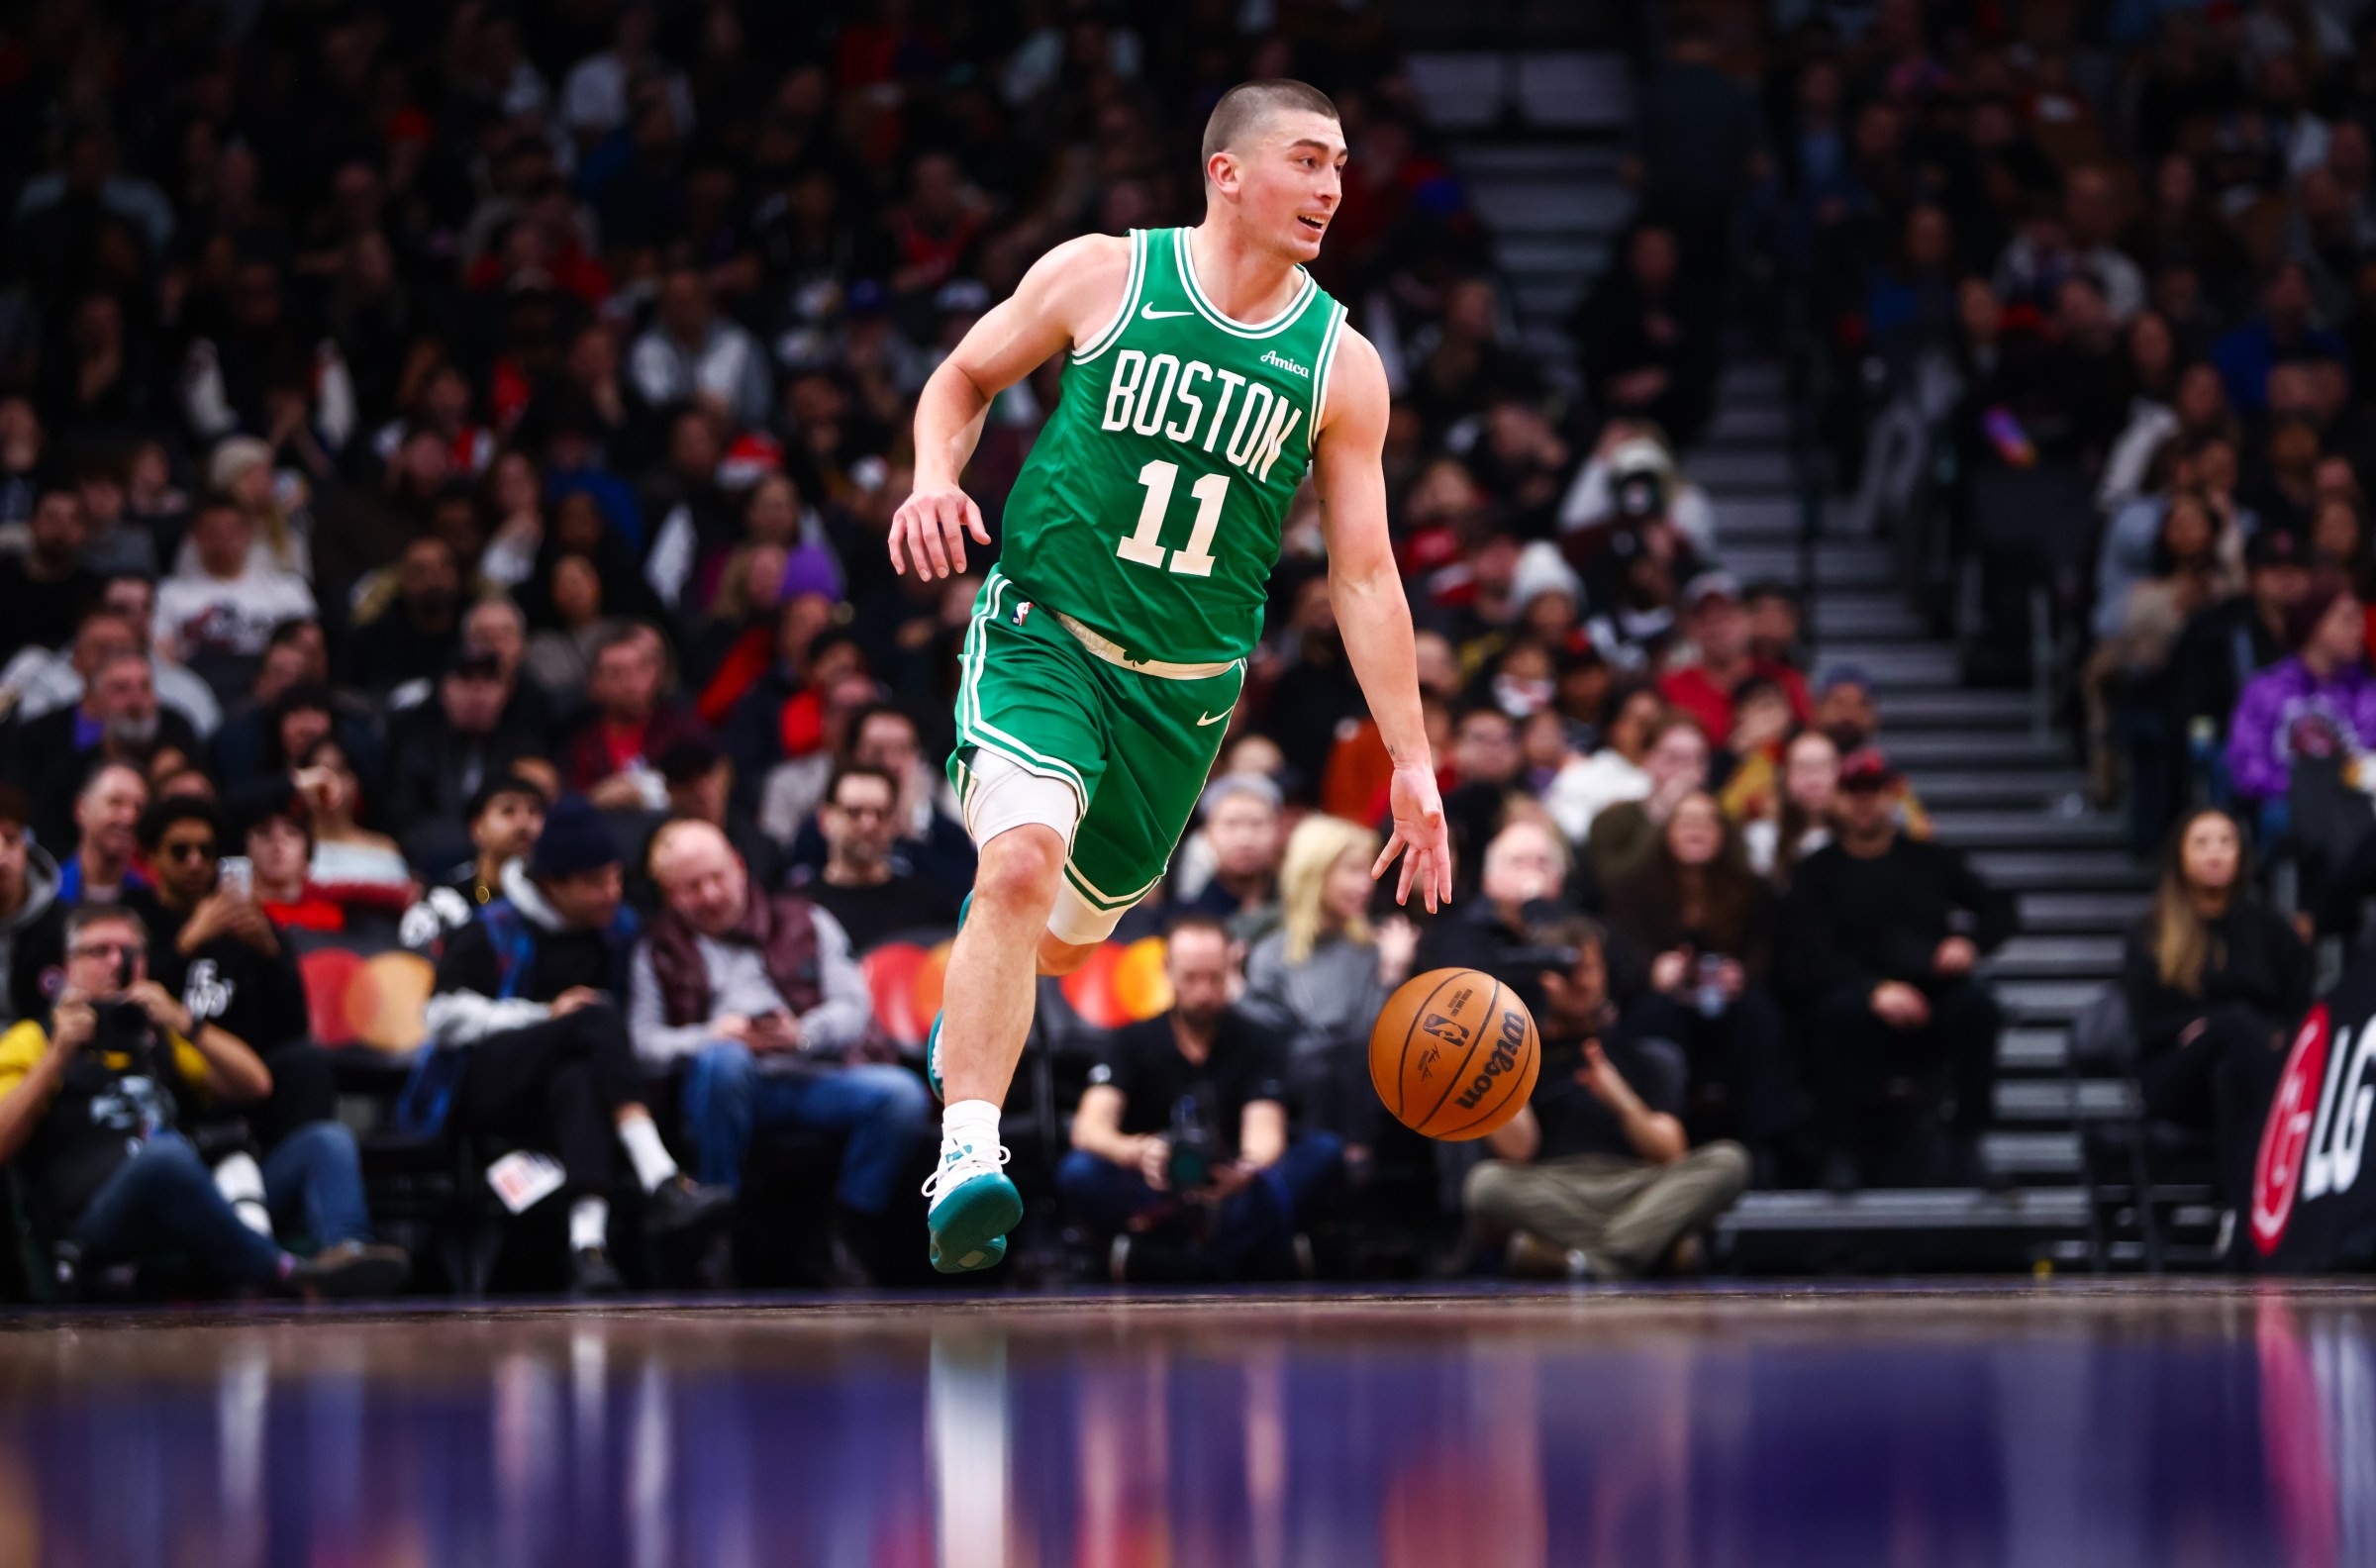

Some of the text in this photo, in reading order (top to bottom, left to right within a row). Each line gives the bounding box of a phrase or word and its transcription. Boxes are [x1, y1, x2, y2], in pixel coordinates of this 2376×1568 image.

[1101, 348, 1303, 483] BOSTON
[1259, 349, 1310, 379] Amica
[1116, 458, 1231, 577] 11
[1455, 1009, 1527, 1110] Wilson
